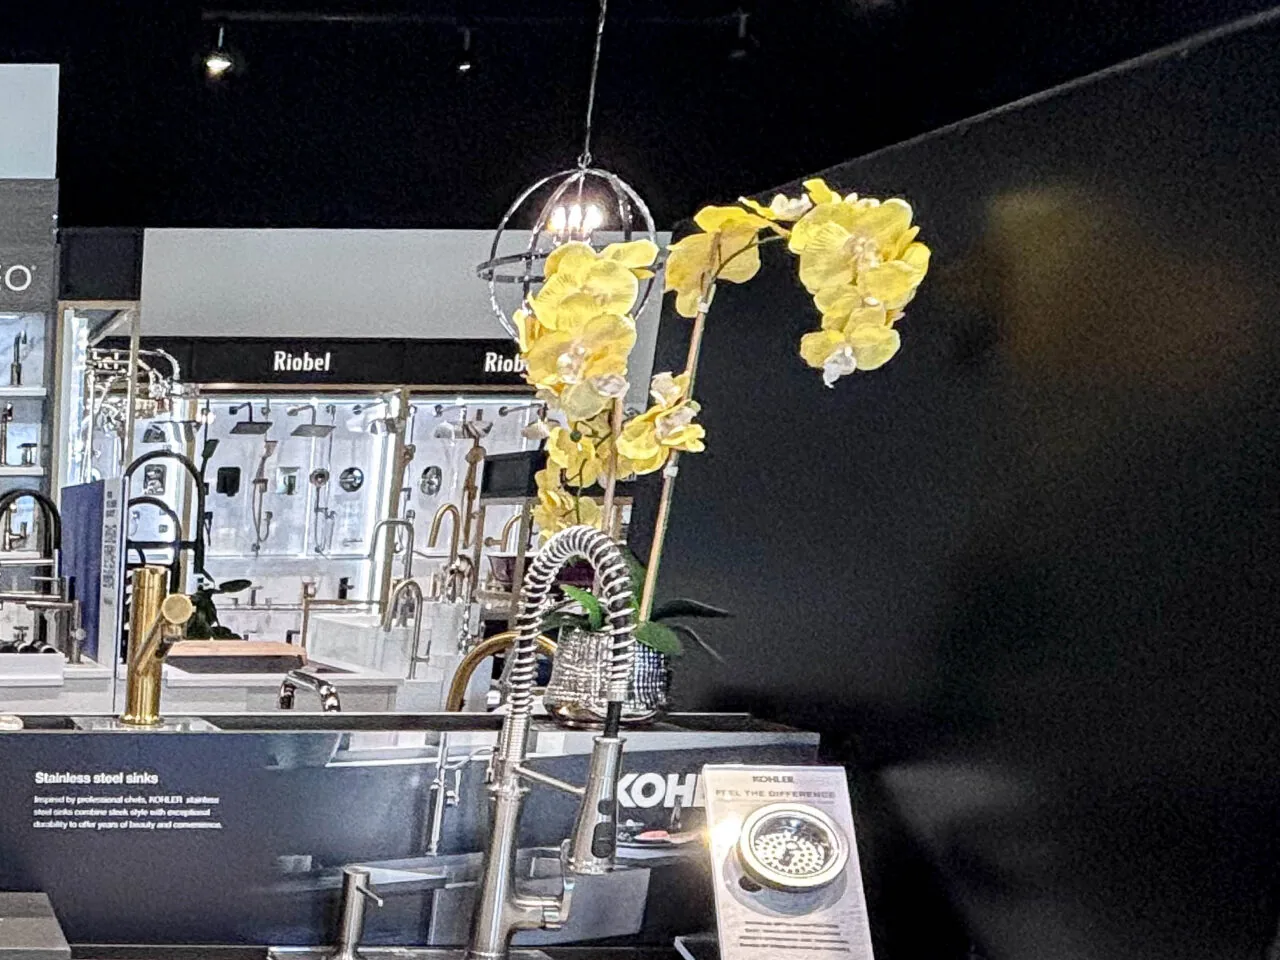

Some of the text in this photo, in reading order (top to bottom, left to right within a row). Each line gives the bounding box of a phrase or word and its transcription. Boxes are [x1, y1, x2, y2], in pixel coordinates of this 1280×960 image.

[273, 350, 331, 371] Riobel
[484, 351, 529, 372] Riob
[35, 771, 159, 785] Stainless steel sinks
[617, 772, 707, 809] KOH
[744, 790, 766, 798] THE
[768, 790, 837, 799] DIFFERENCE
